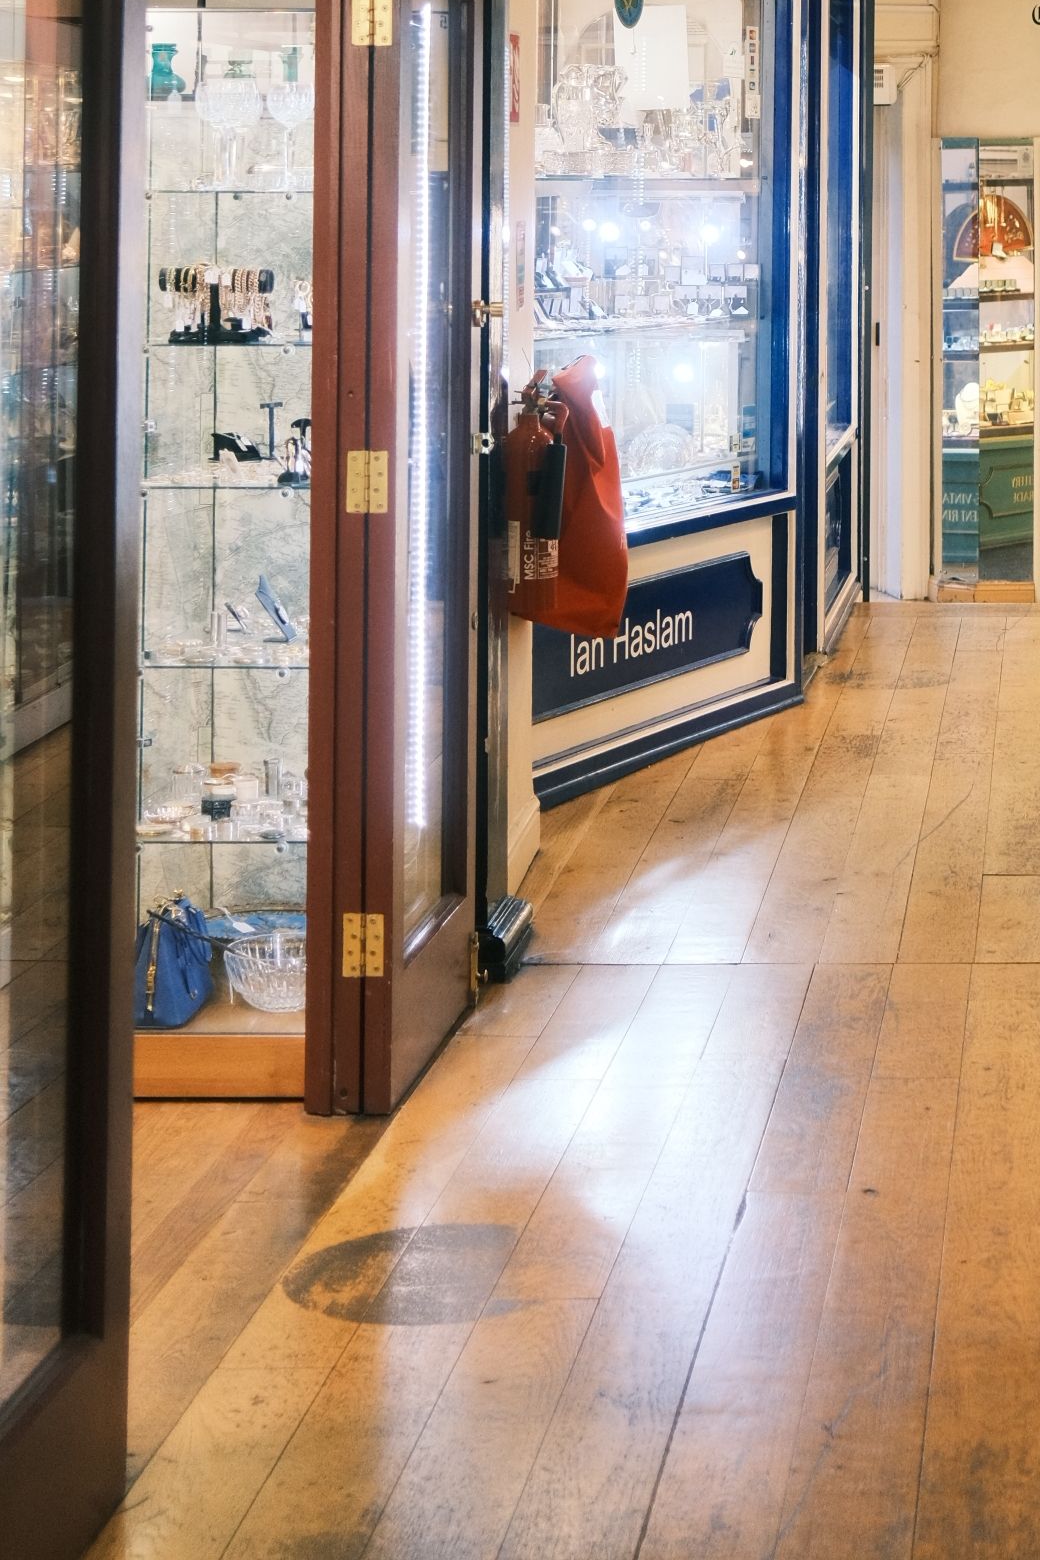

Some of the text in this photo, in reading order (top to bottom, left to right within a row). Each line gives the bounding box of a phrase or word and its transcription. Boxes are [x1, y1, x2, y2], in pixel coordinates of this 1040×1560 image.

[523, 554, 535, 580] MSC
[570, 608, 693, 678] Ian Haslam
